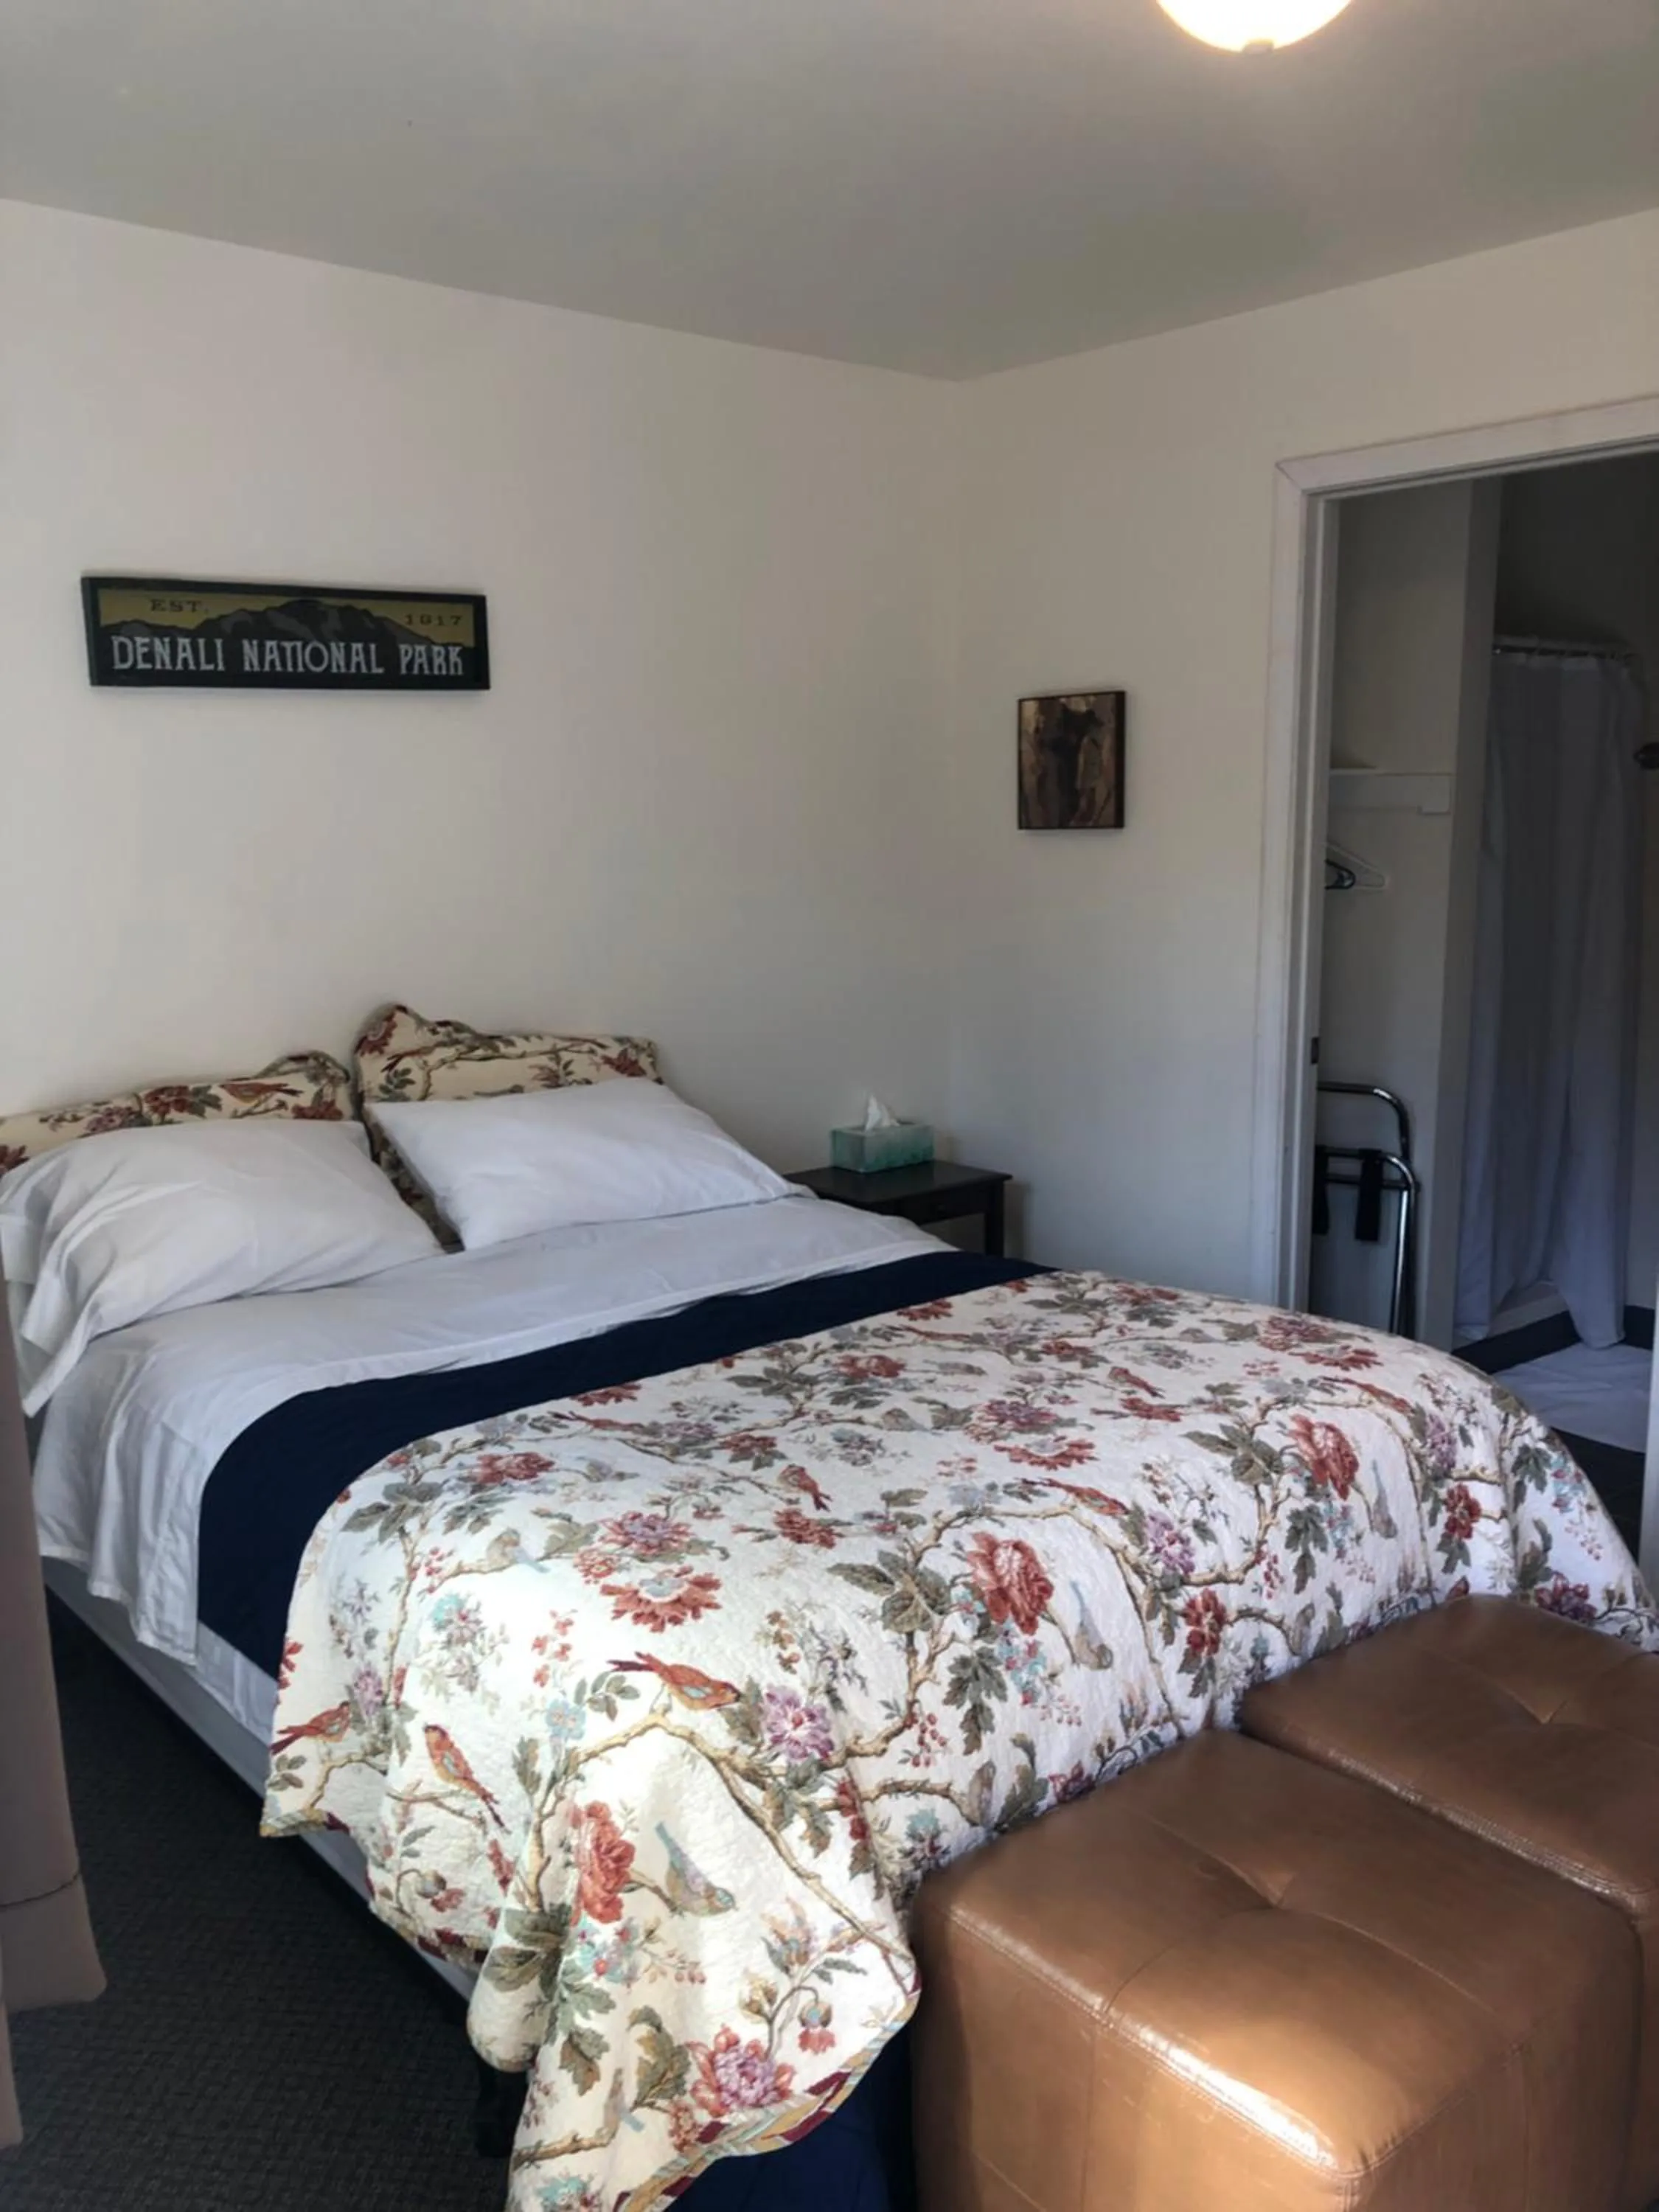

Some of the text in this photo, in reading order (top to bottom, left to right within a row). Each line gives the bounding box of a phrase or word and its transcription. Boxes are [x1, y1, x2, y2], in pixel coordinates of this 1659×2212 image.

[111, 636, 464, 675] DENALI NATIONAL PARK
